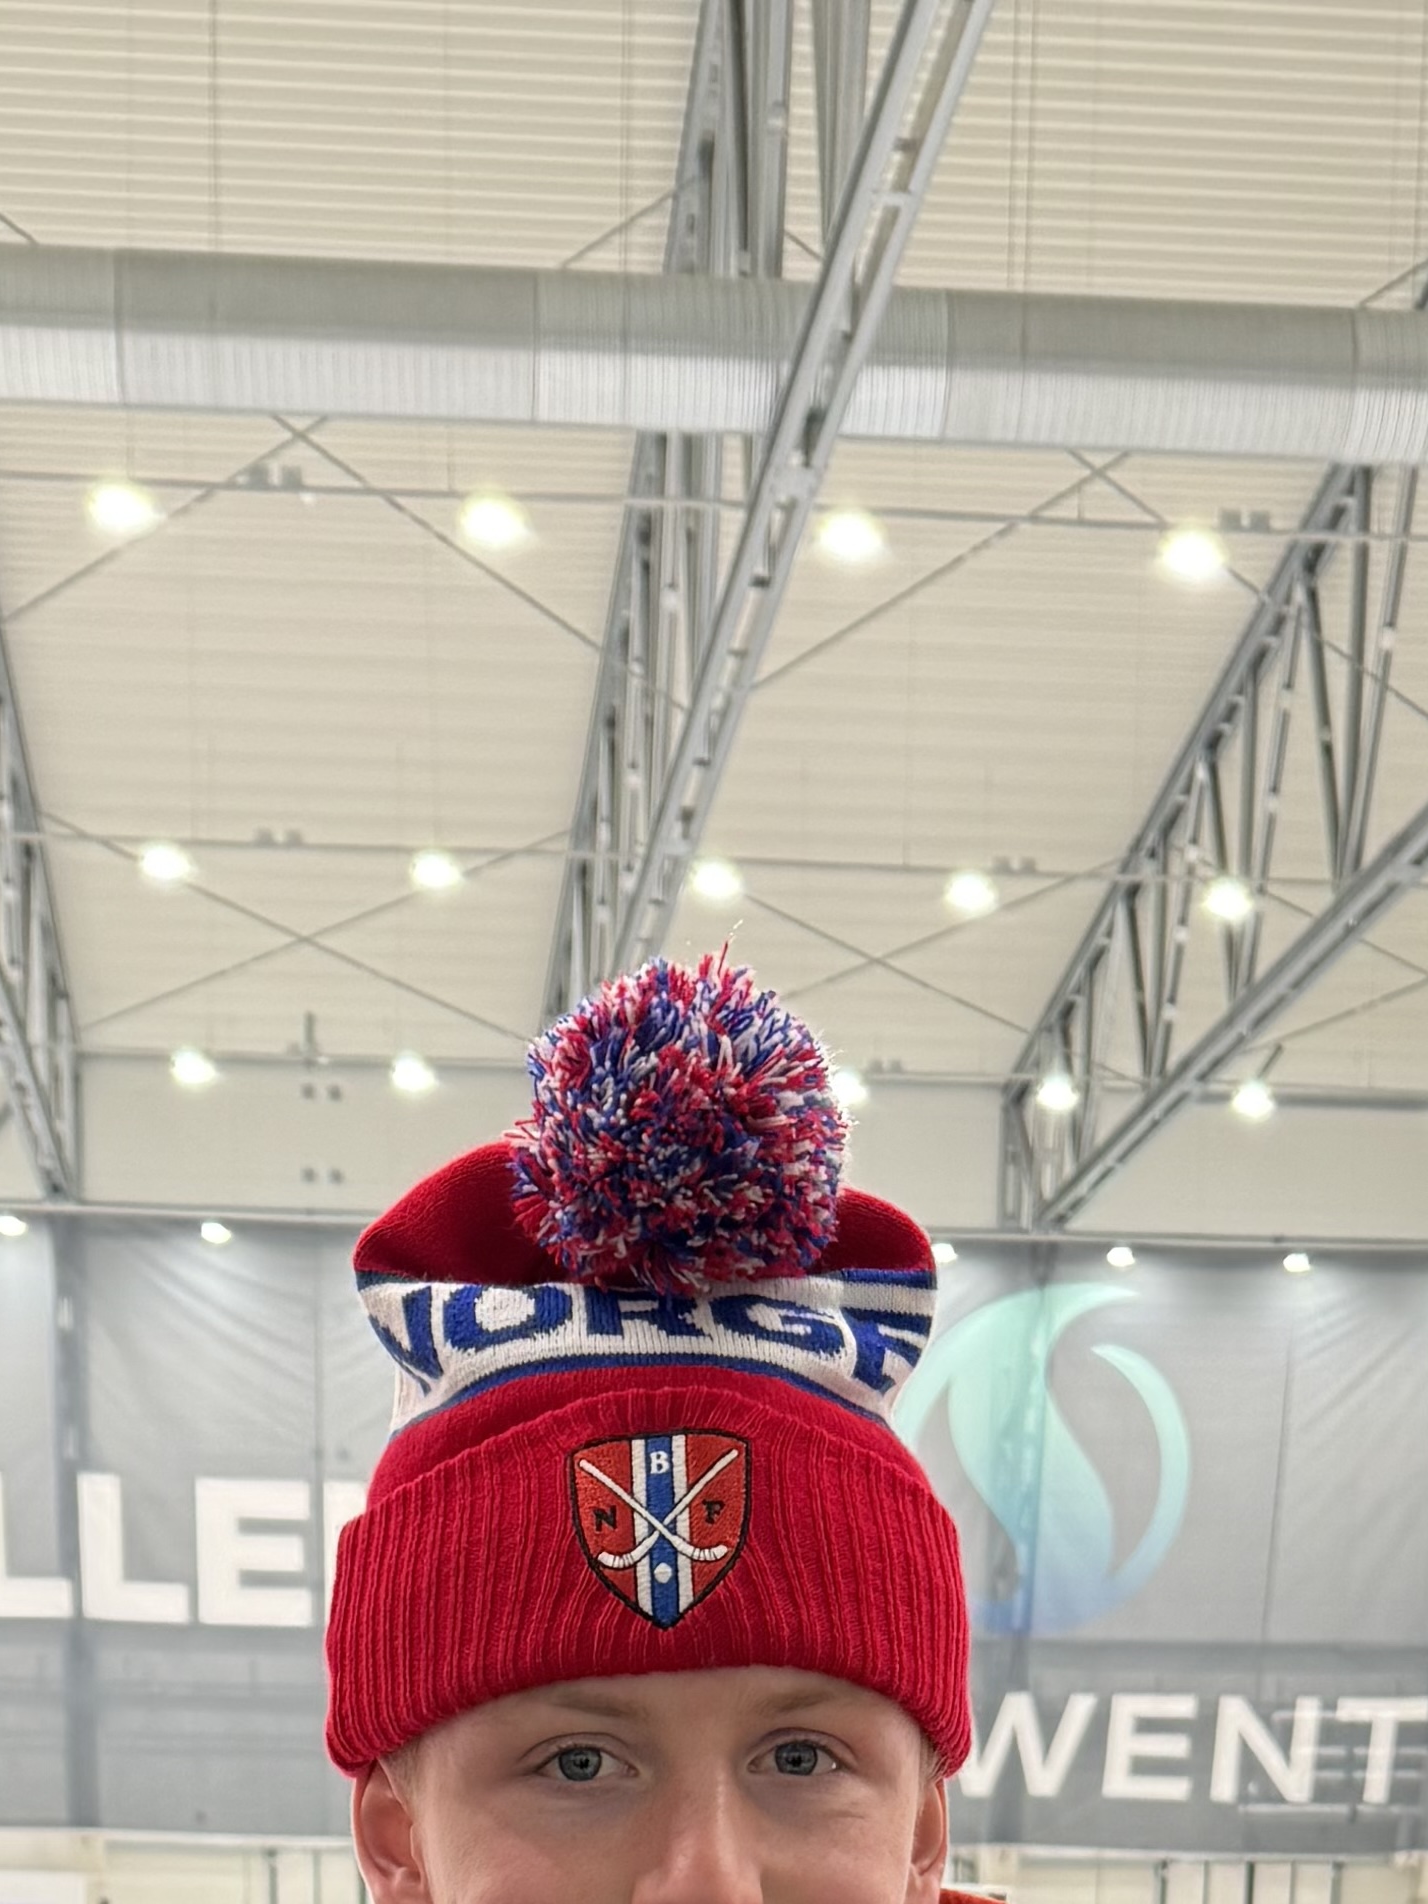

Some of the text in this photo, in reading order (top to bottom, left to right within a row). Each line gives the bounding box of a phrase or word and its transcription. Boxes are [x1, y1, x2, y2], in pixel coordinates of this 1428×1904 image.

[649, 1450, 671, 1475] B
[592, 1499, 725, 1532] N F
